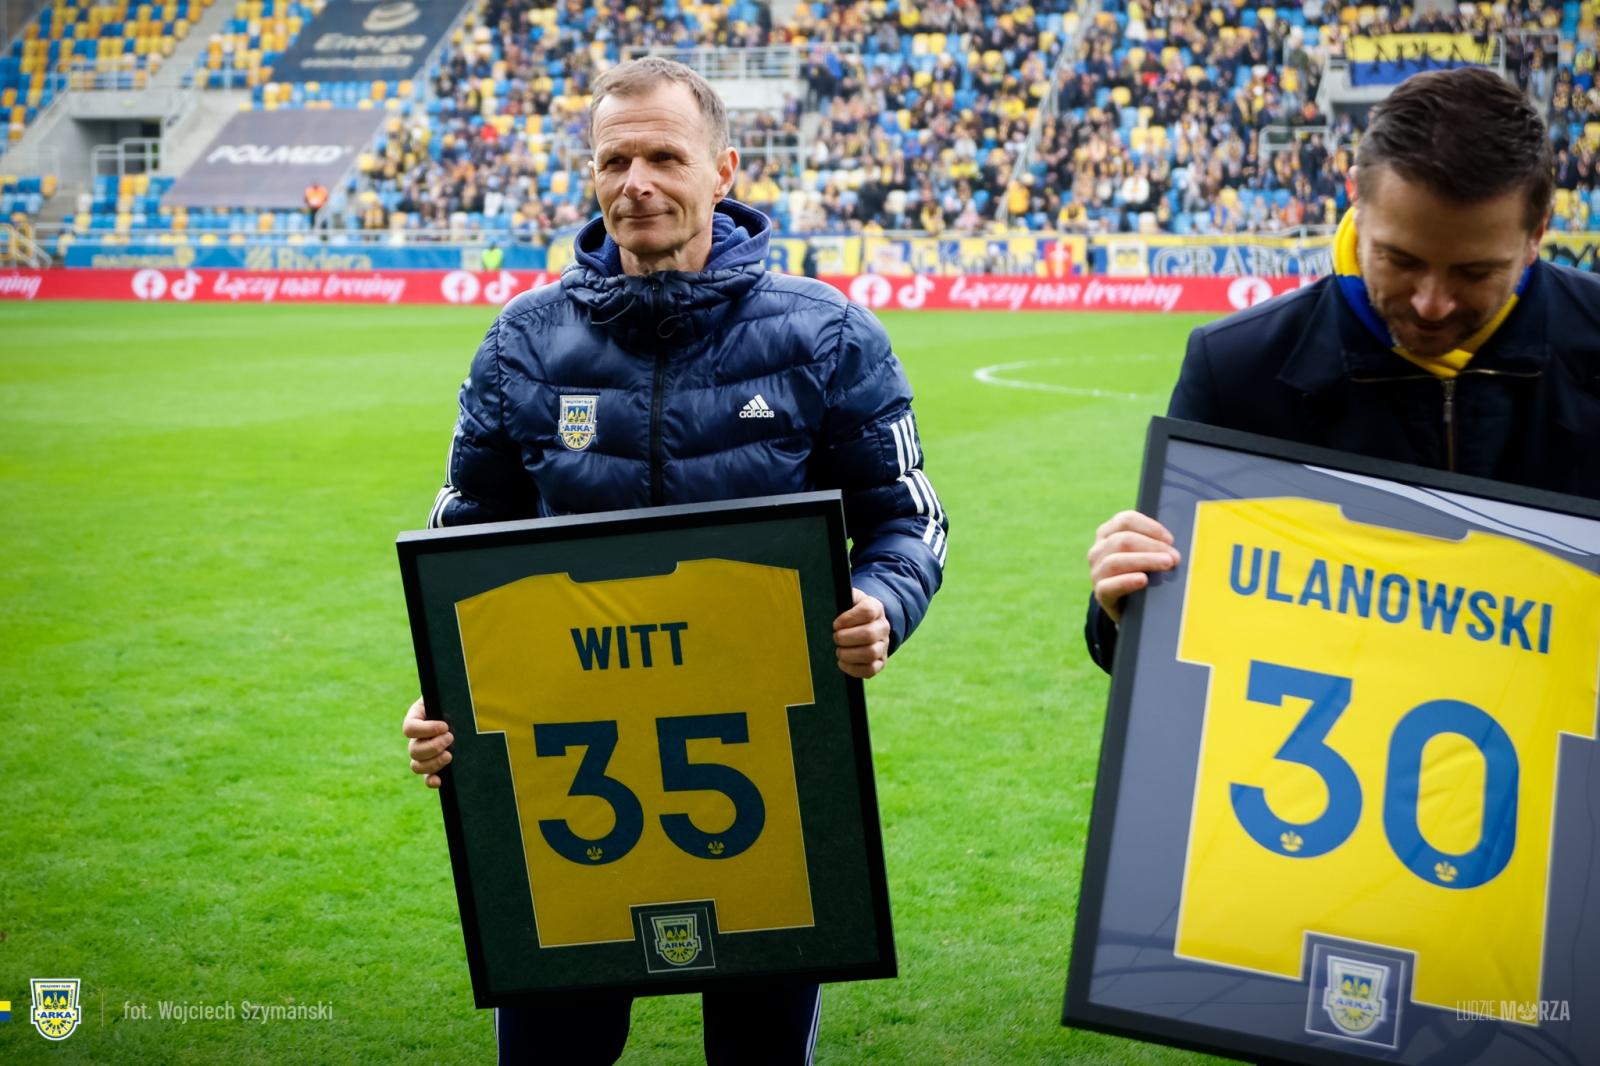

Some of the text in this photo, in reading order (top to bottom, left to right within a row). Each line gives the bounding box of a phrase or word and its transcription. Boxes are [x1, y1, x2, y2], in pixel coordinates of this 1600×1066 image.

[314, 33, 427, 54] Energa
[207, 145, 343, 165] POLMED
[280, 277, 322, 297] nas
[322, 274, 406, 304] trening
[1030, 282, 1081, 305] nas
[1082, 278, 1183, 312] trening
[564, 424, 591, 432] ARKA
[739, 409, 775, 418] adidas
[1229, 543, 1553, 654] ULANOWSKI
[570, 621, 688, 671] WITT
[533, 712, 766, 866] 35
[1229, 659, 1520, 889] 30
[1335, 997, 1373, 1011] ARKA
